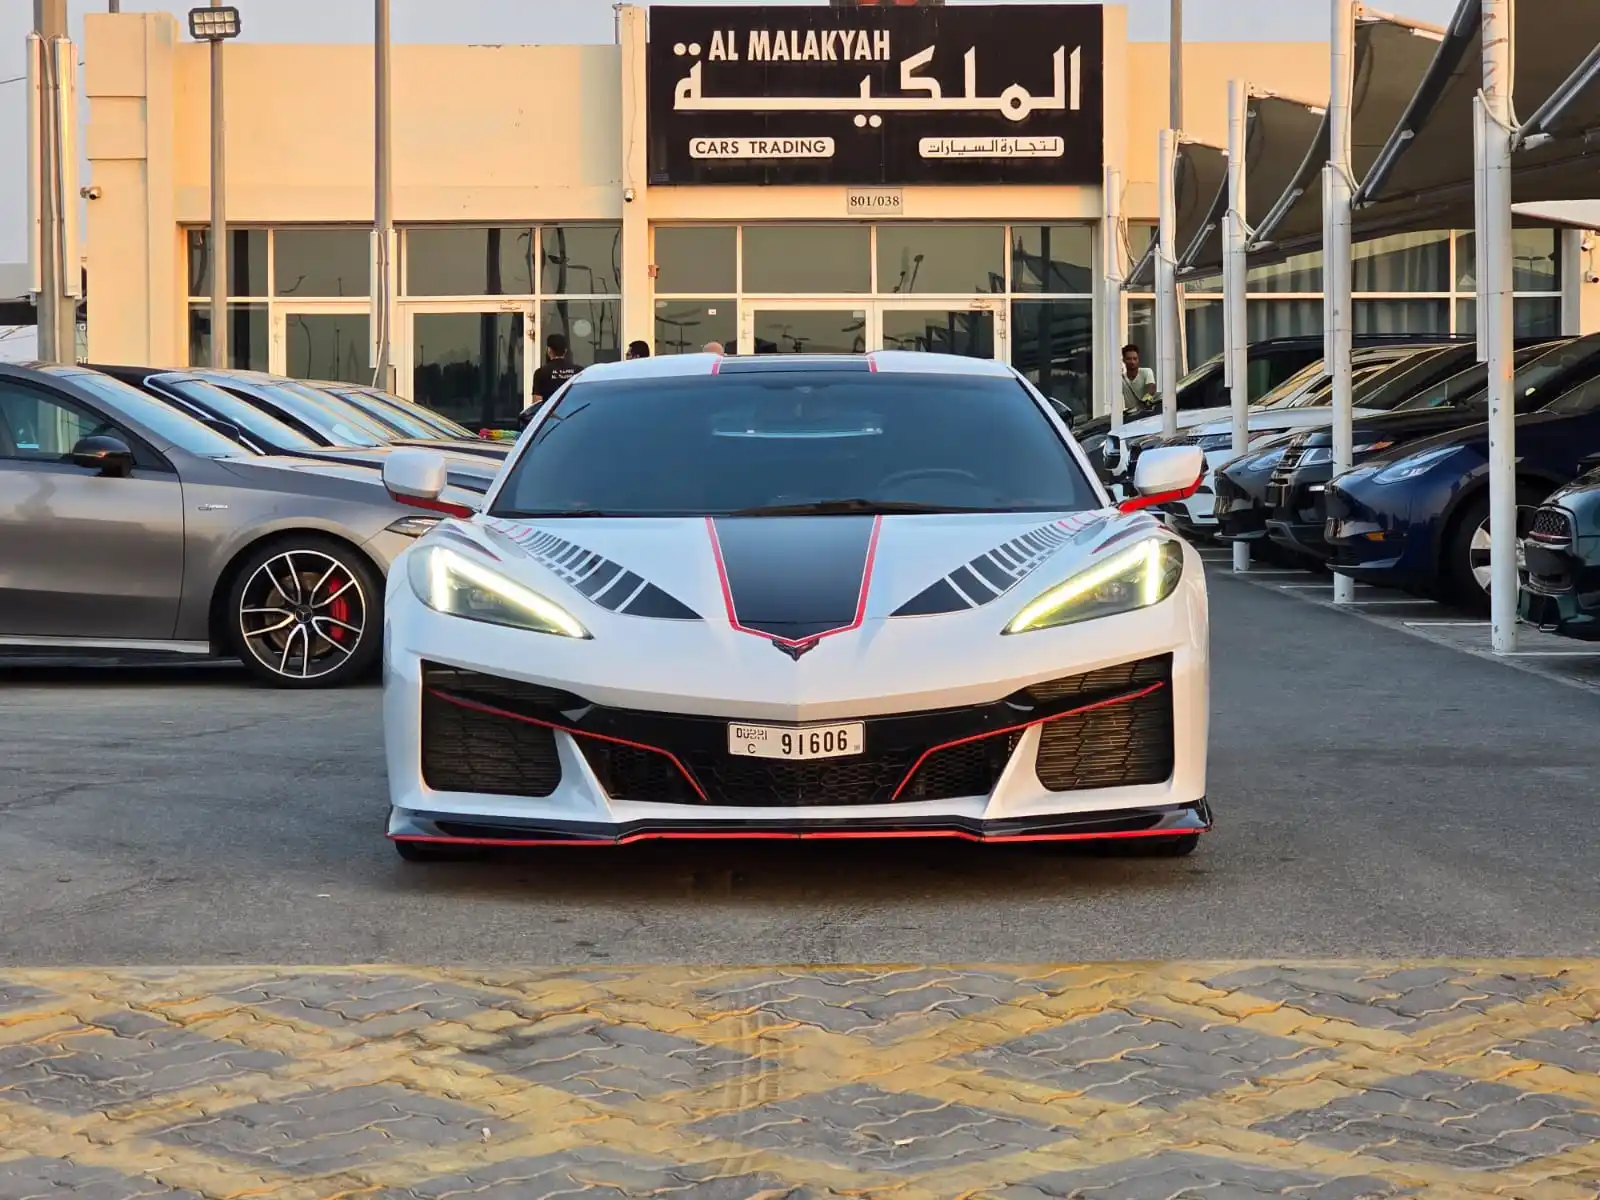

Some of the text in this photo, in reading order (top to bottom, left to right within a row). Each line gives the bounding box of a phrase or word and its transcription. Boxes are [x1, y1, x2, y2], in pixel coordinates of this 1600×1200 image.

[708, 30, 890, 61] AL MALAKYAH
[673, 43, 1081, 128] الملكية
[695, 140, 826, 154] CARS TRADING
[928, 138, 1057, 156] لتجارة السيارات
[850, 195, 900, 207] 801/038
[747, 743, 756, 754] C
[781, 729, 848, 755] 91606
